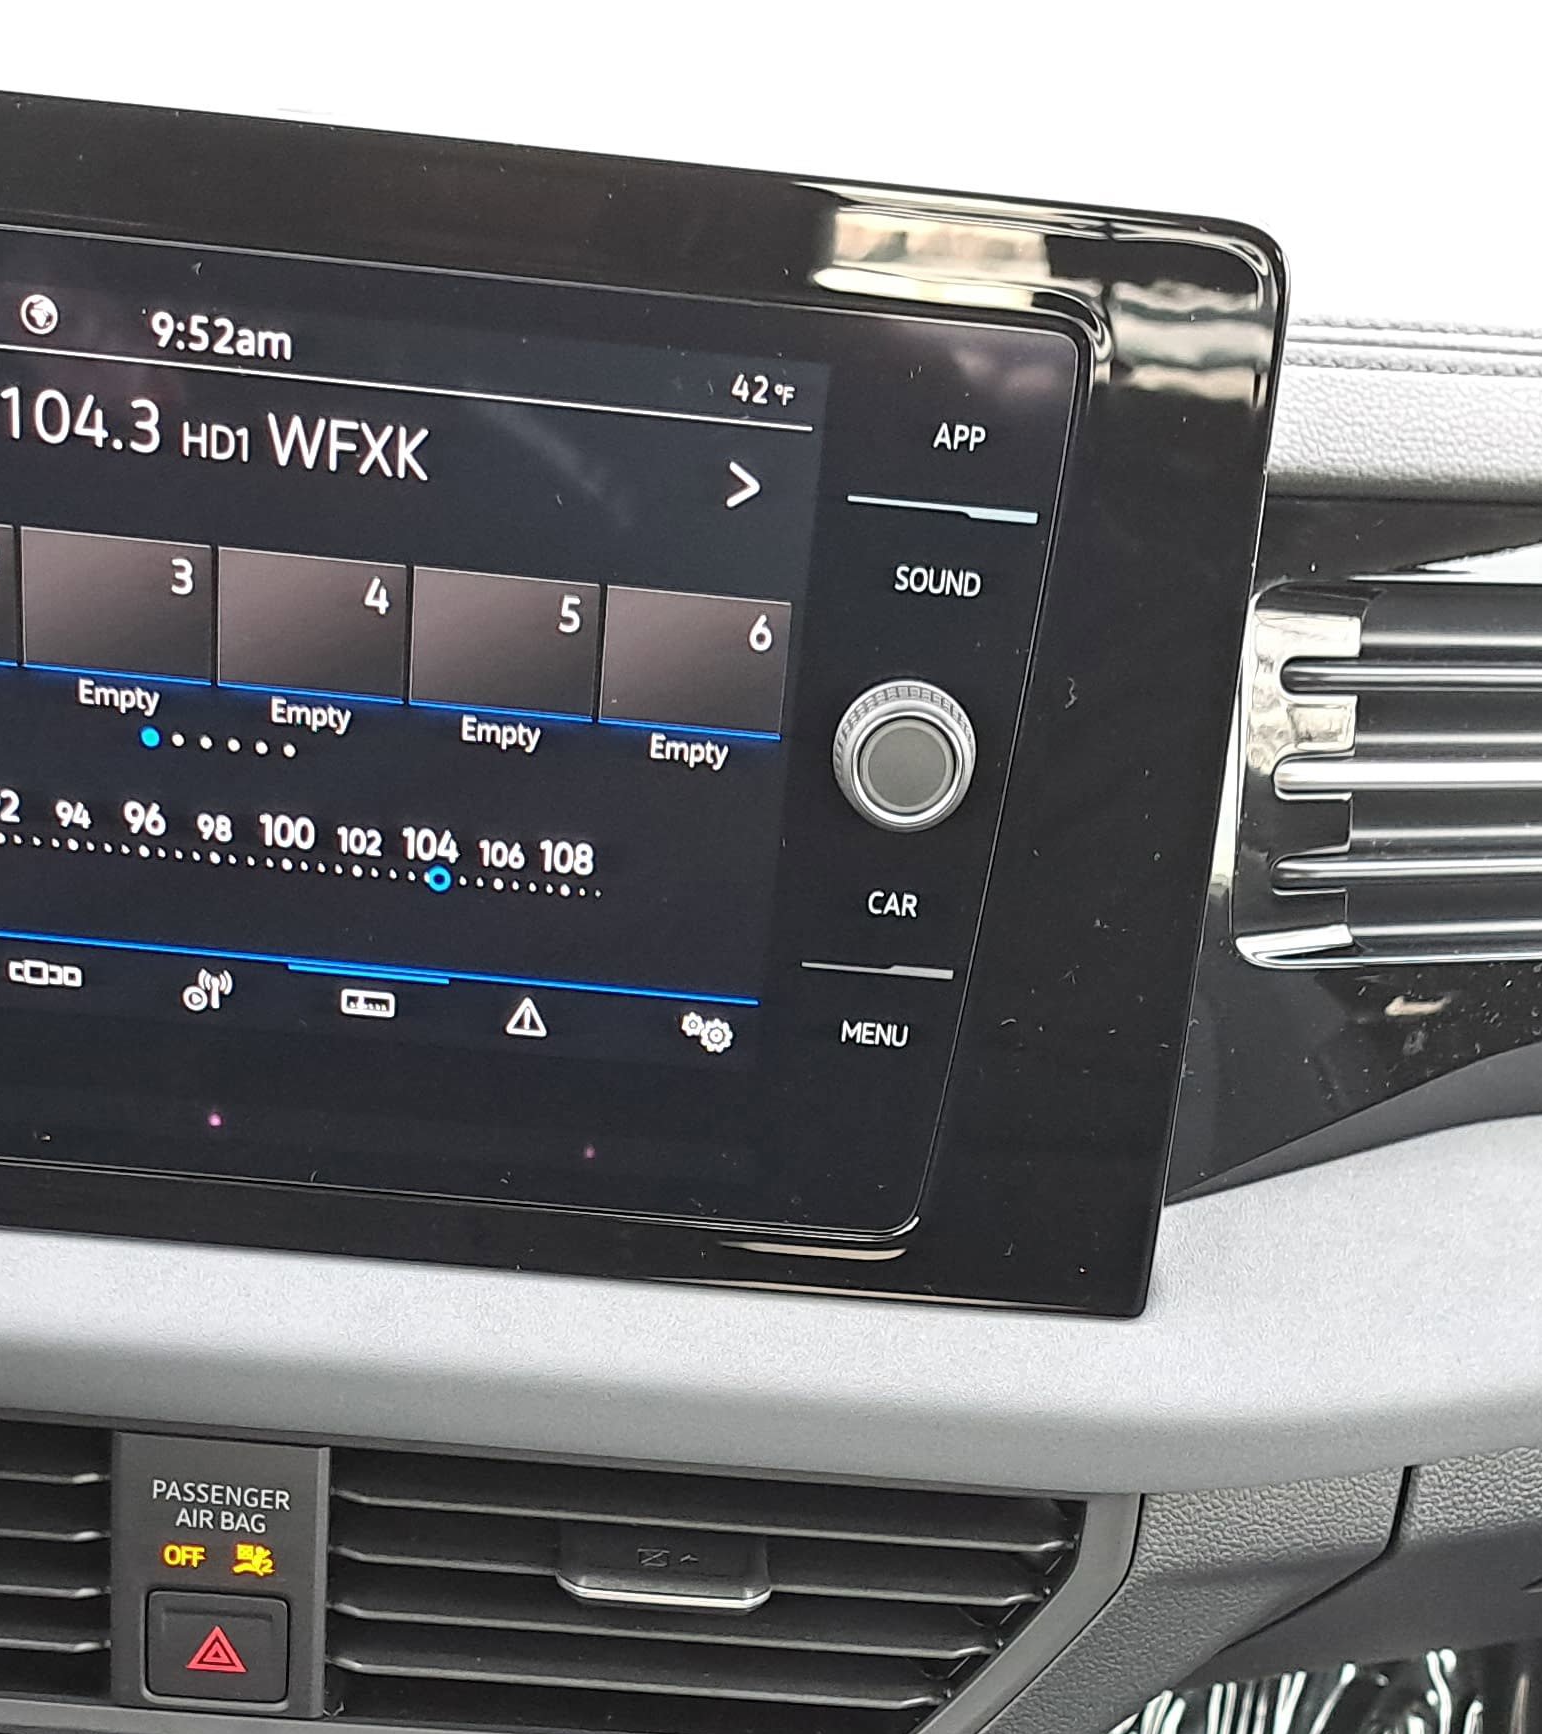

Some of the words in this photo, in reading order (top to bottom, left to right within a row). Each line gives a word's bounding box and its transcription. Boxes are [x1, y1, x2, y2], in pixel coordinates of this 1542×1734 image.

[151, 311, 293, 361] 9:52am
[0, 385, 161, 455] 104.3
[181, 421, 250, 463] HD1
[267, 411, 430, 482] WFXK
[933, 421, 987, 452] APP
[170, 558, 194, 595] 3
[894, 564, 982, 598] SOUND
[363, 577, 390, 615] 4
[558, 595, 581, 634] 5
[749, 614, 773, 652] 6
[78, 678, 160, 716] Empty
[270, 697, 352, 735] Empty
[461, 714, 542, 753] Empty
[649, 732, 729, 771] Empty
[55, 800, 92, 829] 94
[123, 800, 166, 836] 96
[196, 813, 233, 843] 98
[260, 812, 316, 850] 100
[336, 825, 382, 857] 102
[403, 826, 459, 863] 104
[479, 839, 525, 870] 106
[540, 839, 594, 876] 108
[867, 890, 918, 918] CAR
[841, 1020, 909, 1048] MENU
[152, 1479, 291, 1511] PASSENGER
[175, 1508, 214, 1529] AIR
[220, 1510, 267, 1534] BAG
[163, 1544, 206, 1568] OFF
